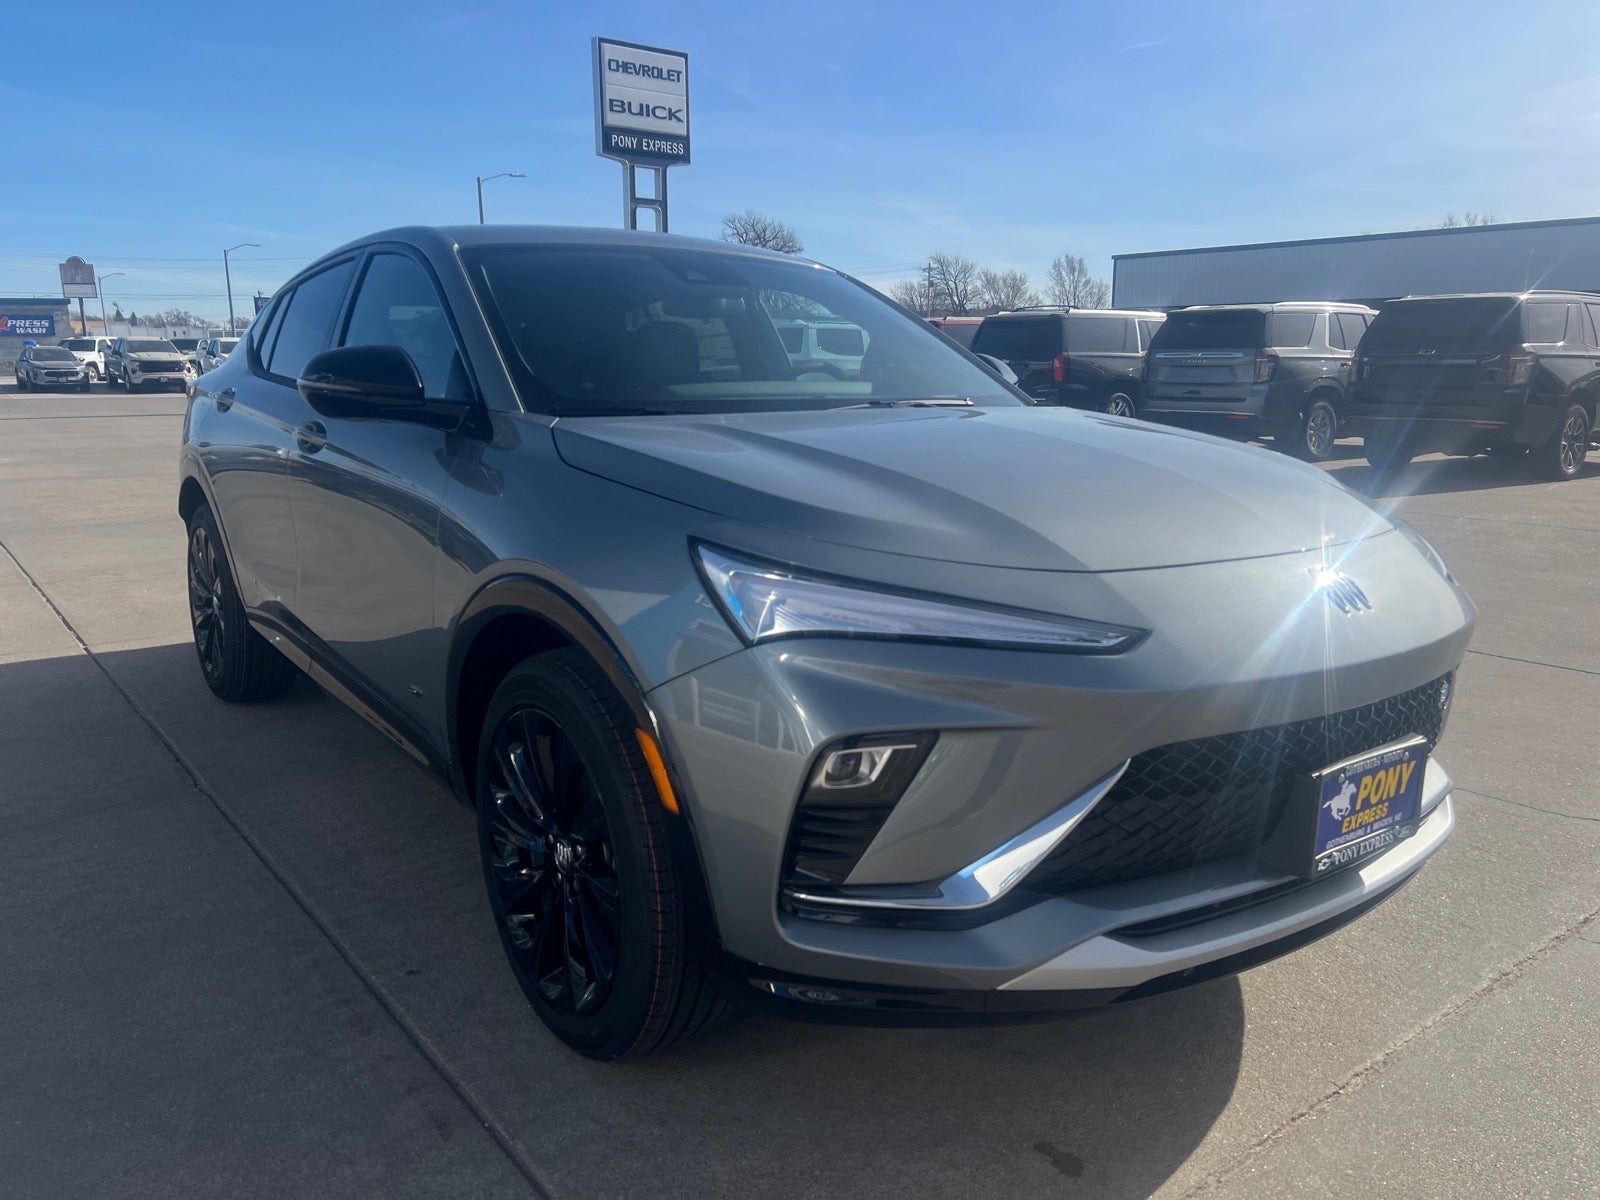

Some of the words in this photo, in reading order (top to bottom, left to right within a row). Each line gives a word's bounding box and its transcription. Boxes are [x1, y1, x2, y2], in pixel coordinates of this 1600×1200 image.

[607, 58, 682, 83] CHEVROLET
[608, 97, 684, 123] BUICK
[611, 134, 637, 149] PONY
[642, 138, 684, 155] EXPRESS
[1356, 760, 1416, 810] PONY
[1341, 802, 1389, 833] EXPRESS
[1333, 845, 1359, 865] PONY
[1359, 833, 1393, 854] EXPRESS
